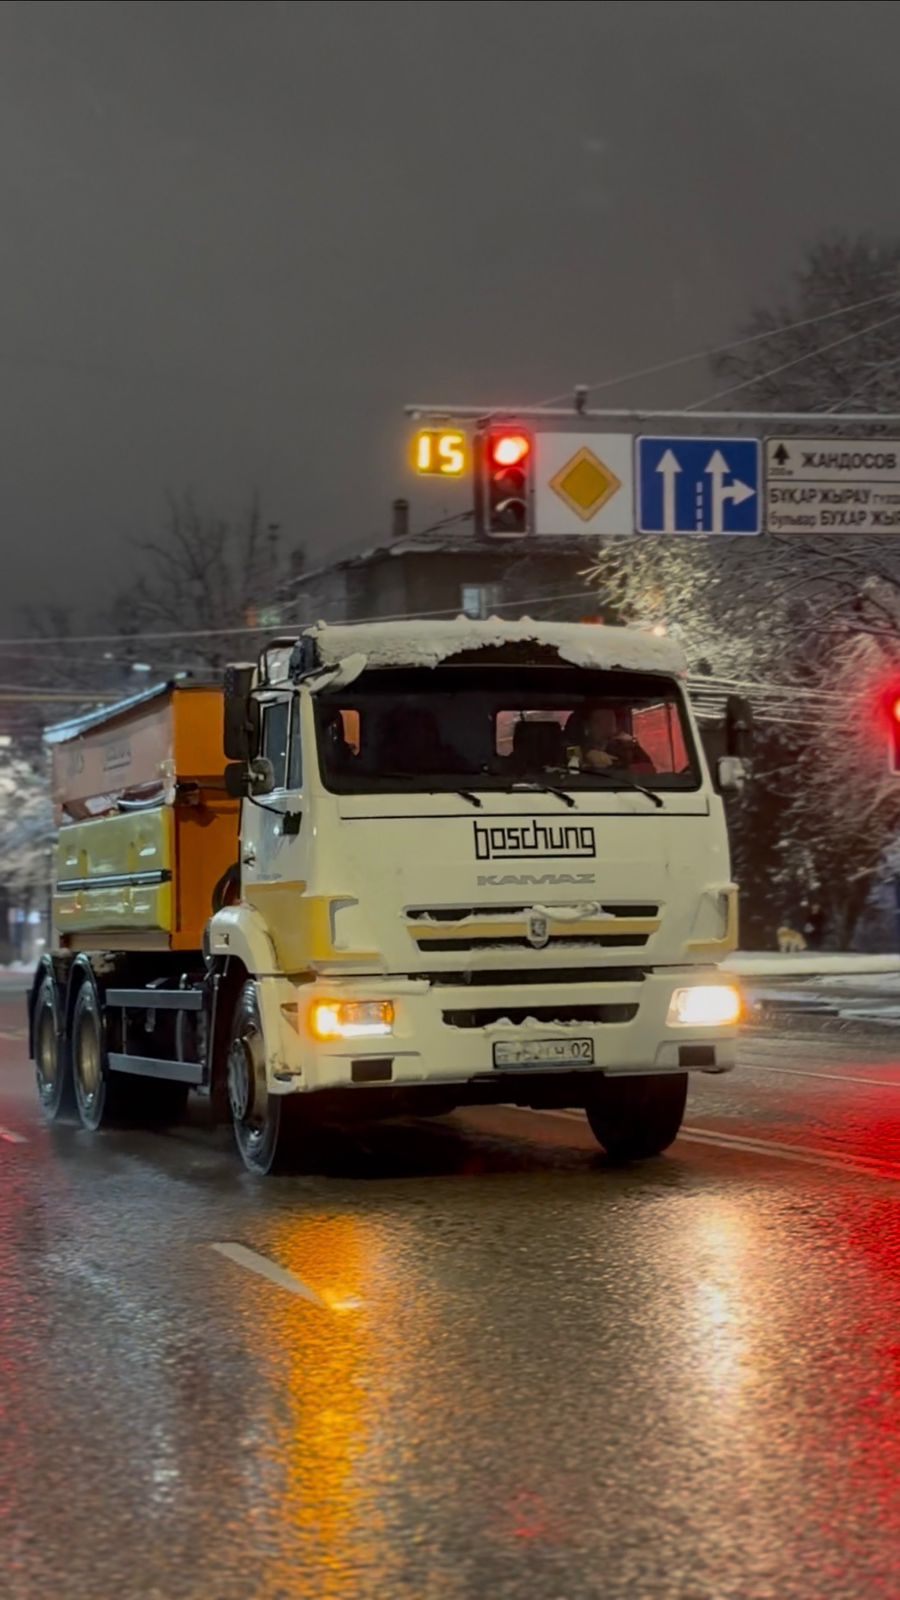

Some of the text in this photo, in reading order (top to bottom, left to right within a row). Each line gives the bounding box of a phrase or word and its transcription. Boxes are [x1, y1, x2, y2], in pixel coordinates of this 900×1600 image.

[417, 434, 464, 472] 15
[801, 452, 897, 471] ЖАНДОСОВ
[820, 509, 867, 526] БУХАР
[473, 819, 596, 860] boschung
[477, 873, 596, 886] KAMAZ
